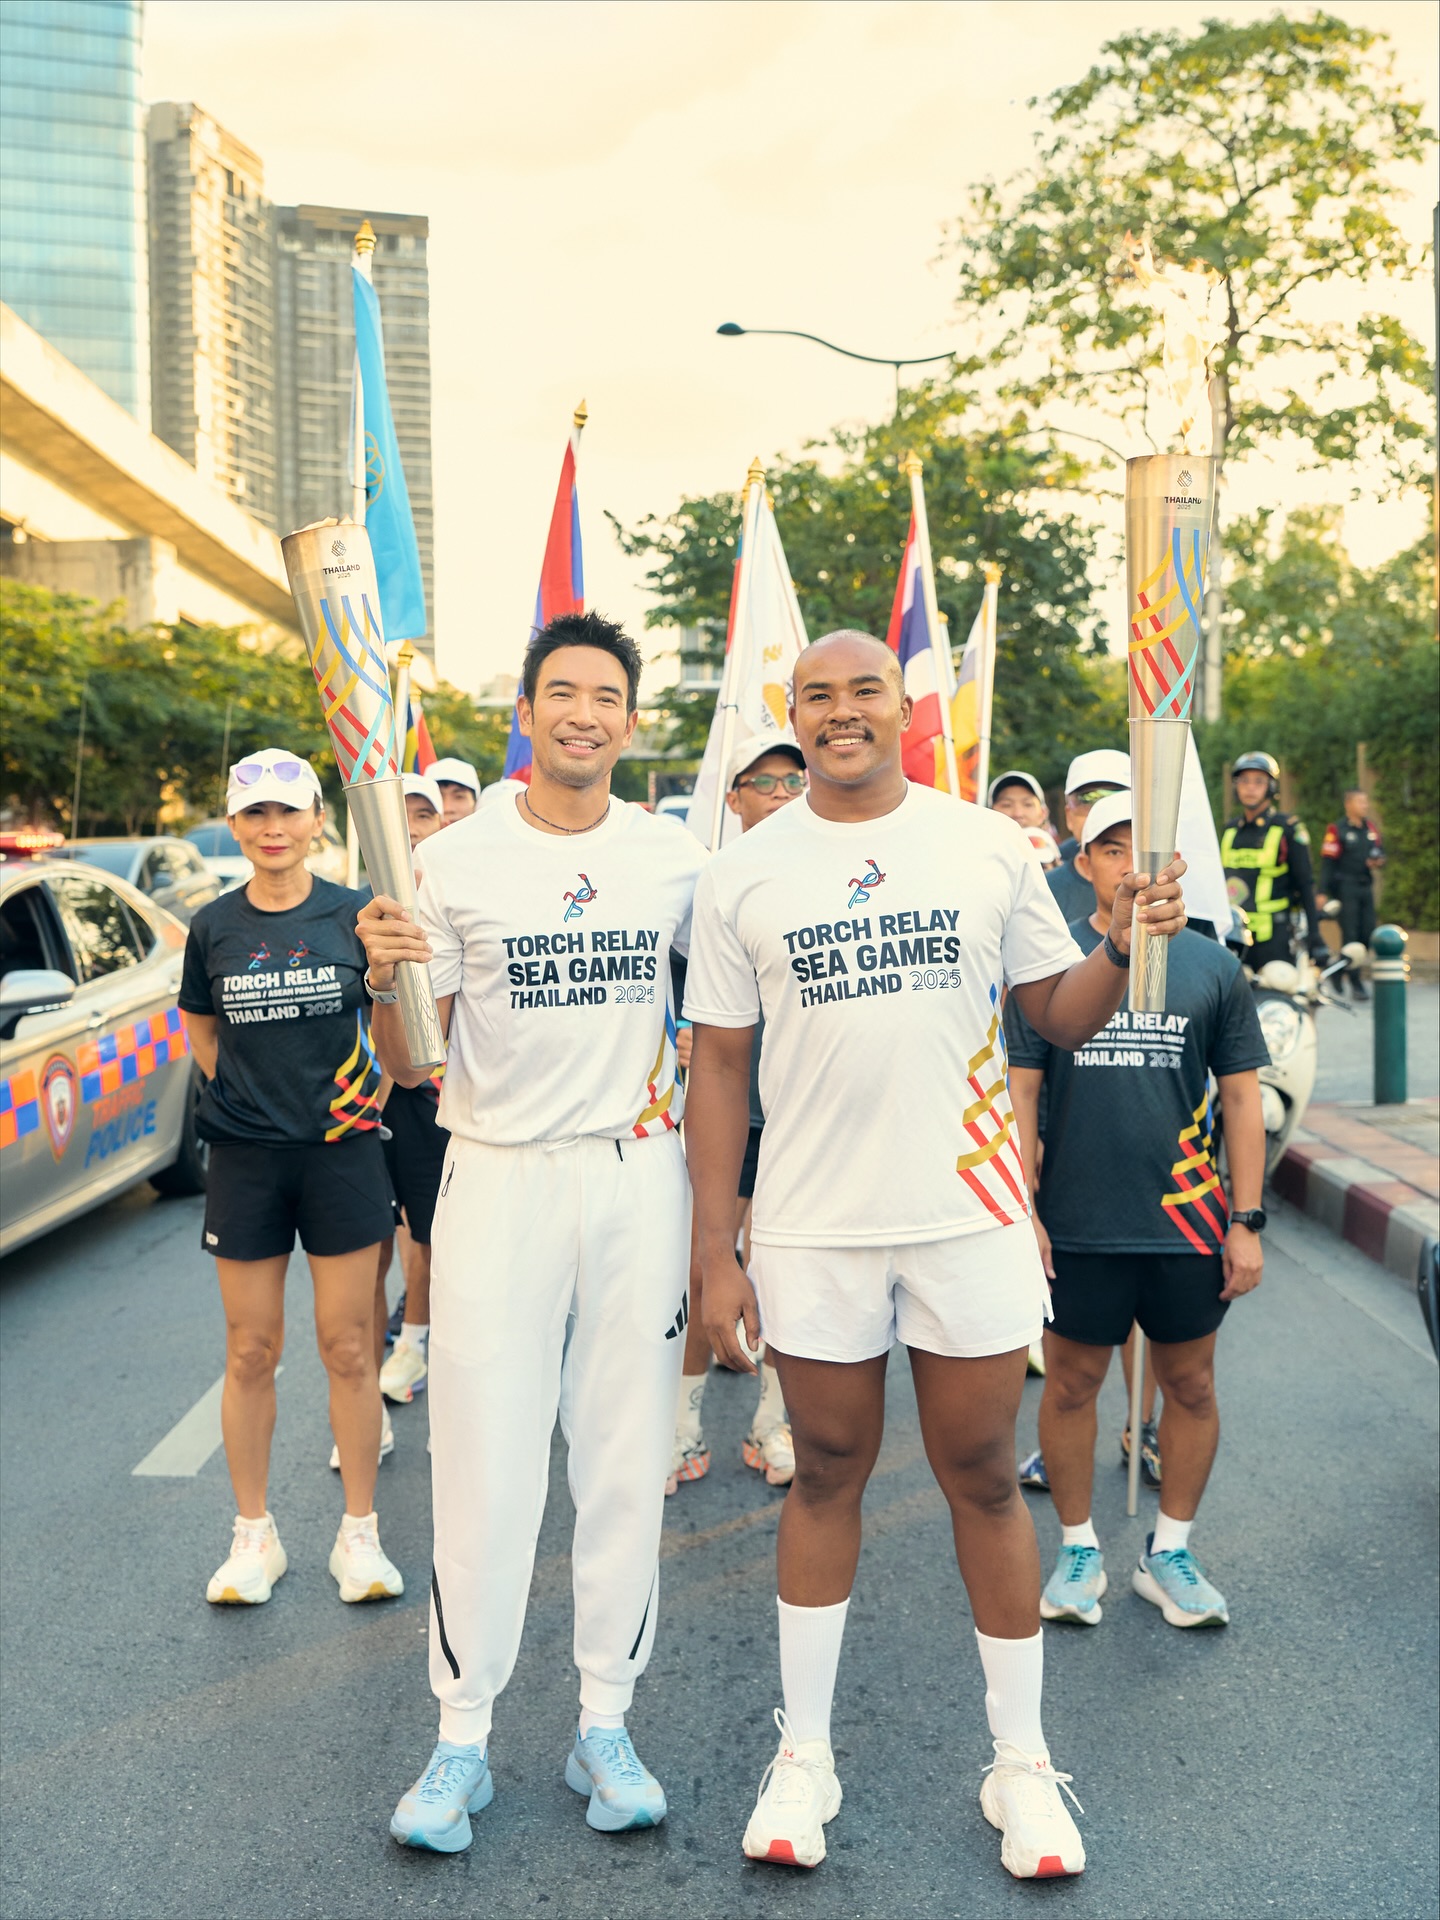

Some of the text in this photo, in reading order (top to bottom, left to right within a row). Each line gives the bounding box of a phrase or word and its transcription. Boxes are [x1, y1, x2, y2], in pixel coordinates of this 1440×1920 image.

[1164, 496, 1202, 504] THAILAND
[322, 563, 361, 575] THAILAND
[502, 930, 660, 958] TORCH RELAY
[783, 909, 960, 955] TORCH RELAY
[507, 955, 657, 986] SEA GAMES
[791, 936, 961, 983] SEA GAMES
[222, 993, 235, 1002] SEA
[235, 991, 262, 1001] GAMES
[268, 988, 294, 998] ASEAN
[295, 985, 316, 995] PARA
[316, 981, 342, 993] GAMES
[223, 965, 336, 992] TORCH RELAY
[800, 968, 962, 1008] THAILAND 2025
[510, 984, 655, 1009] THAILAND 2025
[225, 1005, 300, 1024] THAILAND
[304, 999, 343, 1017] 2025
[1132, 1013, 1190, 1034] RELAY
[1116, 1031, 1141, 1041] ASEAN
[1141, 1032, 1161, 1042] PARA
[1073, 1050, 1145, 1067] THAILAND
[92, 1079, 146, 1130] TRAFFIC
[83, 1097, 158, 1169] POLICE
